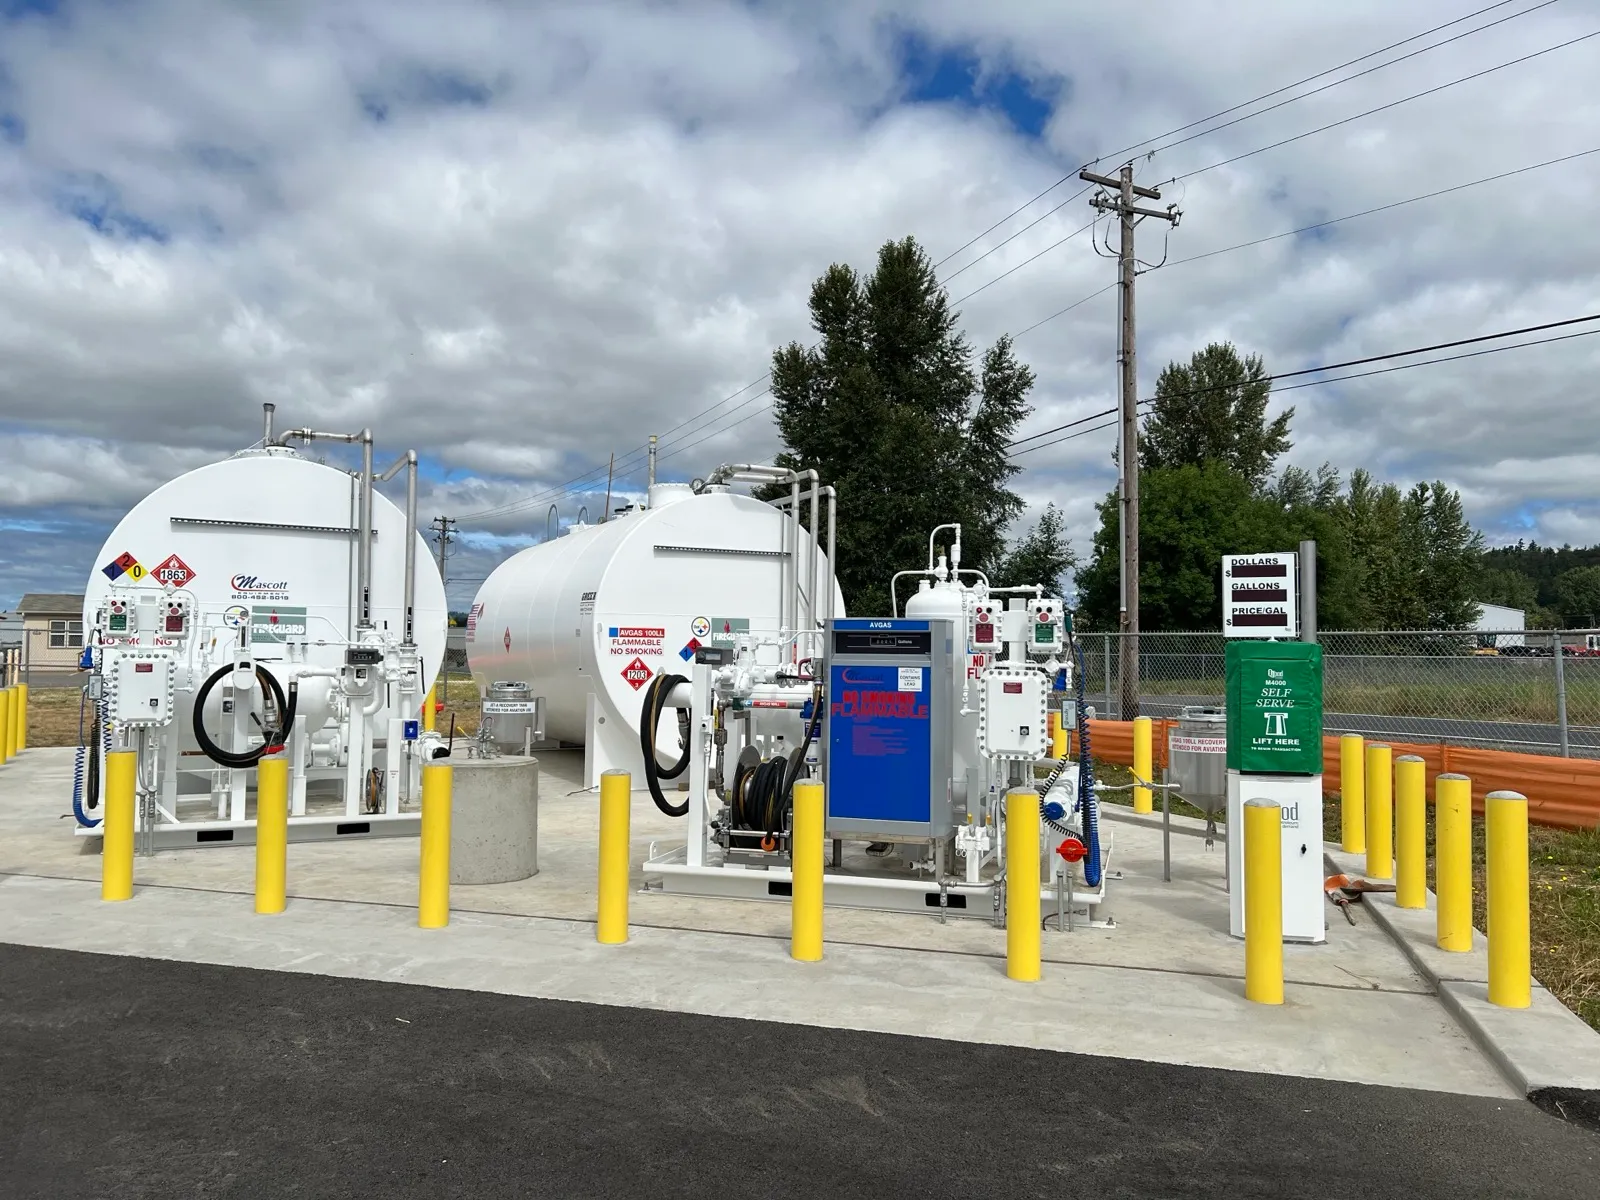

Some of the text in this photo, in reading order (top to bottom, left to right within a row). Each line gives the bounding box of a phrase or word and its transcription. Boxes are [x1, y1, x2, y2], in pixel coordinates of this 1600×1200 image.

[121, 554, 130, 567] 2
[1231, 557, 1279, 566] DOLLARS
[109, 565, 116, 577] 1
[133, 565, 142, 578] 0
[160, 569, 187, 580] 1863
[1225, 569, 1231, 577] $
[236, 575, 288, 589] Mascott
[1231, 582, 1280, 590] GALLONS
[1226, 618, 1232, 626] $
[619, 628, 664, 637] AVGAS 100LL
[612, 638, 661, 646] FLAMMABLE
[610, 647, 663, 655] NO SMOKING
[684, 649, 688, 658] 1
[972, 655, 984, 667] NO
[628, 669, 648, 680] 1203
[1261, 688, 1292, 697] SELF
[1255, 698, 1295, 708] SERVE
[832, 702, 930, 719] FLAMMABLE
[1275, 738, 1300, 746] HERE
